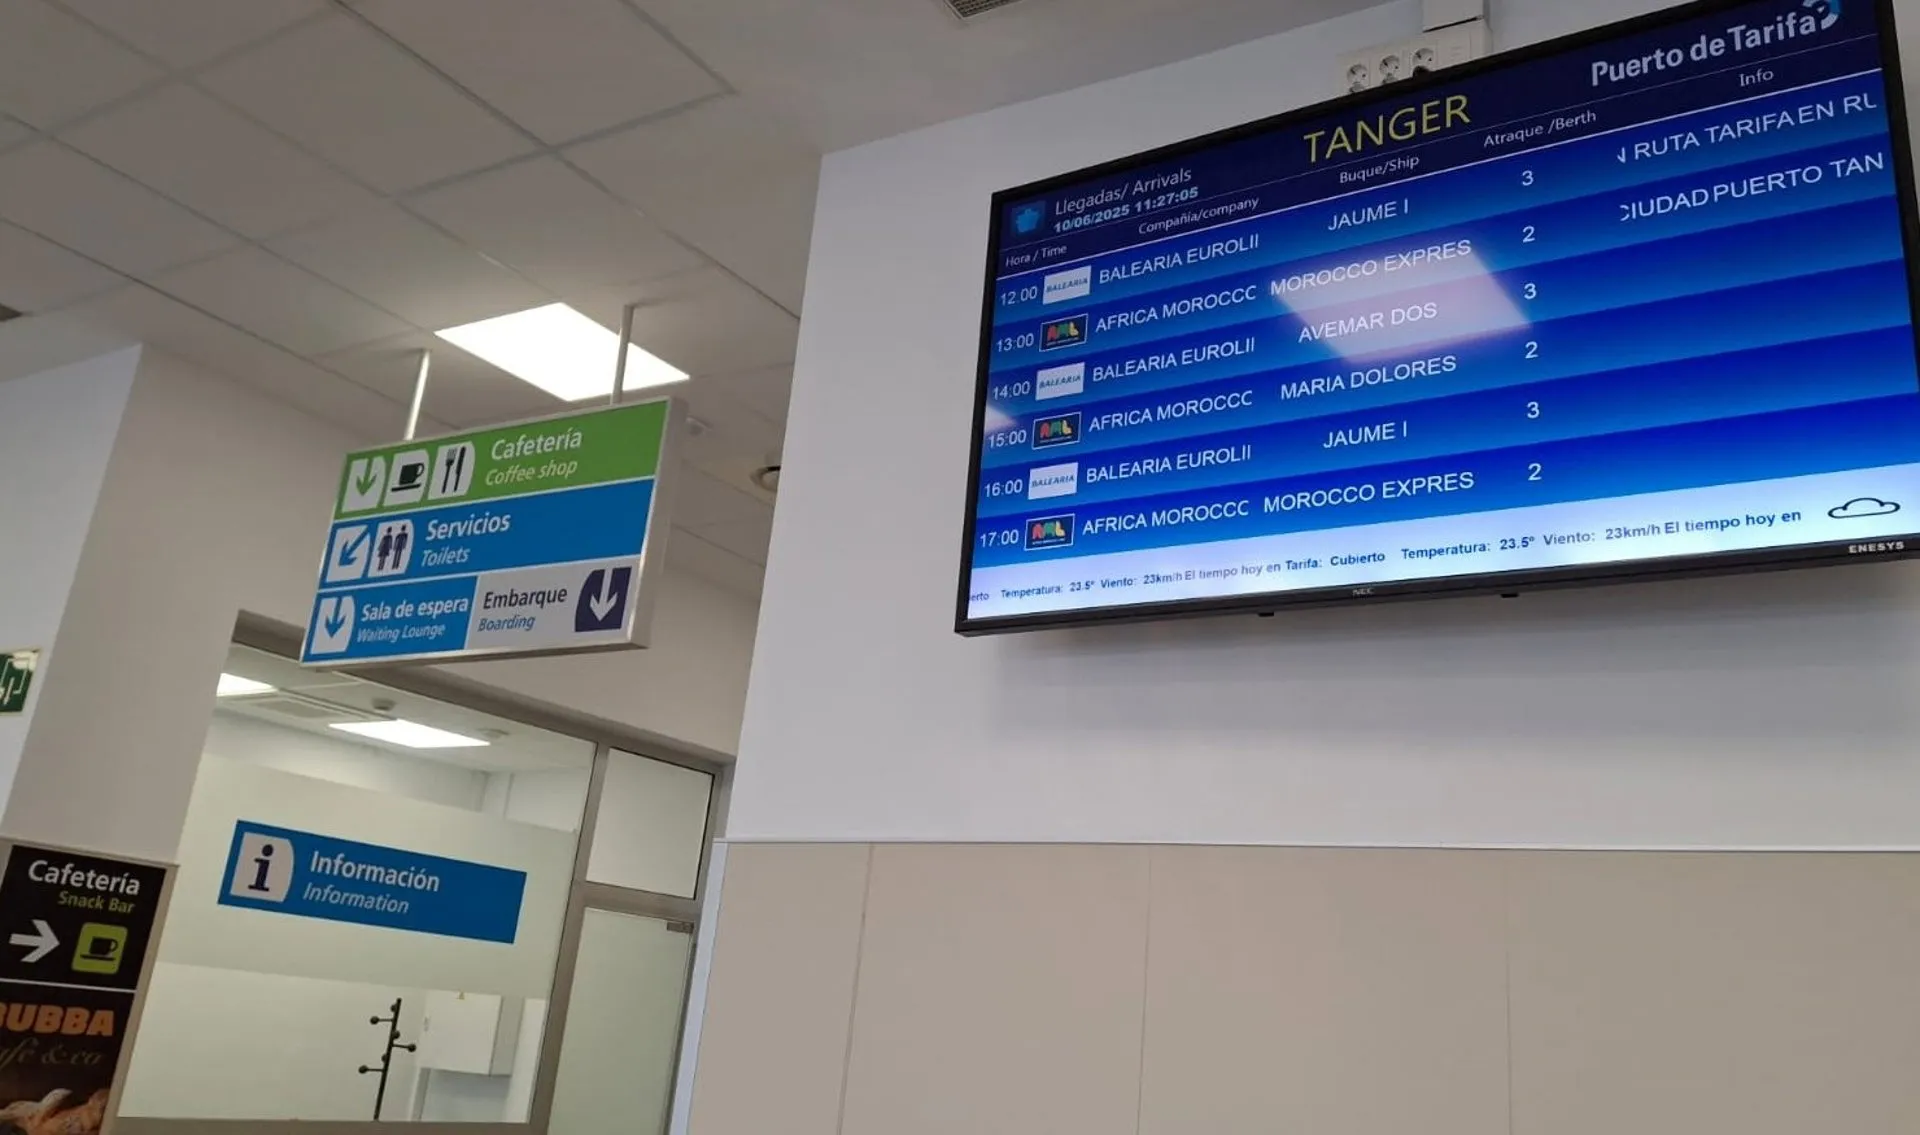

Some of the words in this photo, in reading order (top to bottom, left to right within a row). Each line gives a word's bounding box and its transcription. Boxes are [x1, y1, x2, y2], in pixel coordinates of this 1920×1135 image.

[1591, 48, 1683, 86] Puerto
[1690, 35, 1725, 61] de
[1727, 12, 1816, 51] Tarifa
[1739, 68, 1775, 87] Info
[1303, 94, 1472, 163] TANGER
[1484, 123, 1543, 147] Atraque
[1548, 109, 1597, 135] /Berth
[1634, 132, 1700, 160] RUTA
[1704, 111, 1795, 144] TARIFA
[1798, 100, 1835, 124] EN
[1339, 155, 1420, 184] Buque/Ship
[1522, 170, 1534, 186] 3
[1713, 165, 1822, 203] PUERTO
[1829, 152, 1884, 178] TAN
[1055, 183, 1129, 215] Llegadas/
[1132, 168, 1192, 195] Arrivals
[1054, 207, 1129, 234] 10/06/2025
[1134, 186, 1199, 213] 11:27:05
[1328, 201, 1397, 231] JAUME
[1404, 198, 1408, 214] I
[1522, 226, 1535, 243] 2
[1006, 254, 1031, 267] Hora
[1041, 244, 1068, 259] Time
[1099, 252, 1182, 284] BALEARIA
[1270, 260, 1377, 296] MOROCCO
[1384, 239, 1472, 272] EXPRES
[1524, 283, 1537, 300] 3
[1095, 307, 1158, 333] AFRICA
[1298, 311, 1385, 343] AVEMAR
[1391, 302, 1438, 326] DOS
[997, 333, 1035, 353] 13:00
[1525, 341, 1538, 359] 2
[1093, 352, 1177, 382] BALEARIA
[1280, 375, 1345, 401] MARIA
[1351, 355, 1457, 389] DOLORES
[992, 381, 1031, 401] 14:00
[1088, 408, 1153, 433] AFRICA
[1527, 401, 1540, 419] 3
[491, 427, 582, 462] Cafetería
[988, 429, 1027, 450] 15:00
[1323, 422, 1395, 449] JAUME
[1403, 420, 1407, 437] I
[485, 464, 536, 487] Coffee
[539, 457, 578, 483] shop
[1086, 457, 1172, 484] BALEARIA
[1528, 463, 1542, 481] 2
[984, 478, 1023, 498] 16:00
[1264, 484, 1375, 513] MOROCCO
[1382, 472, 1474, 500] EXPRES
[425, 512, 511, 542] Servicios
[1082, 513, 1147, 536] AFRICA
[980, 529, 1019, 548] 17:00
[1849, 540, 1905, 554] ENESYS
[421, 546, 471, 567] Toilets
[1001, 585, 1064, 600] Temperatura:
[1100, 577, 1138, 589] Viento:
[1184, 571, 1196, 581] El
[1198, 566, 1238, 580] tiempo
[1241, 562, 1262, 577] hoy
[1266, 563, 1281, 573] en
[1286, 558, 1322, 571] Tarifa:
[1330, 552, 1386, 567] Cubierto
[1401, 543, 1490, 560] Temperatura:
[1543, 532, 1595, 546] Viento:
[1605, 524, 1661, 539] 23km/h
[1664, 521, 1680, 534] El
[1685, 516, 1741, 532] tiempo
[1745, 512, 1776, 527] hoy
[1781, 511, 1801, 523] en
[361, 602, 393, 622] Sala
[395, 598, 414, 617] de
[417, 596, 468, 618] espera
[483, 586, 568, 611] Embarque
[356, 626, 400, 644] Waiting
[402, 621, 445, 641] Lounge
[478, 613, 536, 633] Boarding
[28, 860, 140, 896] Cafetería
[310, 850, 440, 893] Información
[58, 891, 104, 910] Snack
[108, 898, 135, 914] Bar
[303, 882, 410, 915] Information
